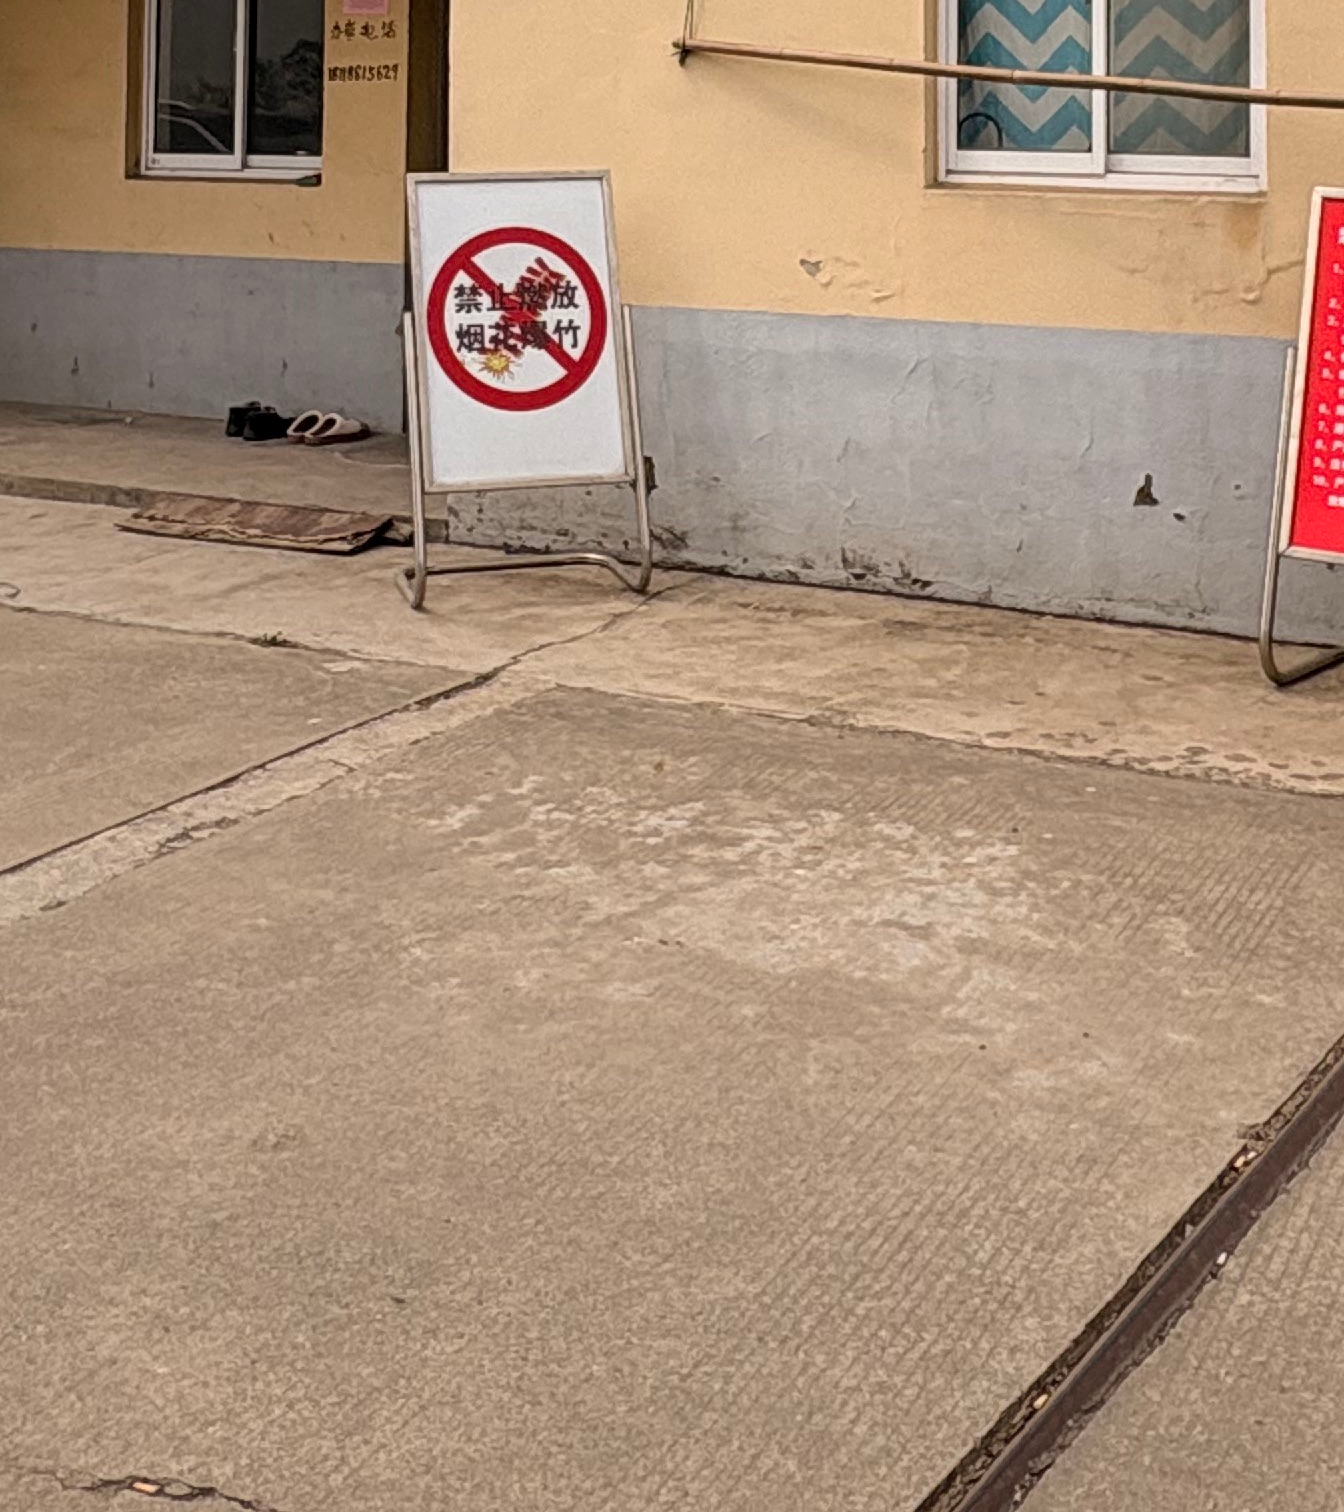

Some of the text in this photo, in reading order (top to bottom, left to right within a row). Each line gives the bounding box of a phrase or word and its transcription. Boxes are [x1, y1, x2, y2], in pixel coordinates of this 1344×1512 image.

[454, 280, 580, 313] 禁止燃放
[455, 319, 581, 353] 烟花爆竹
